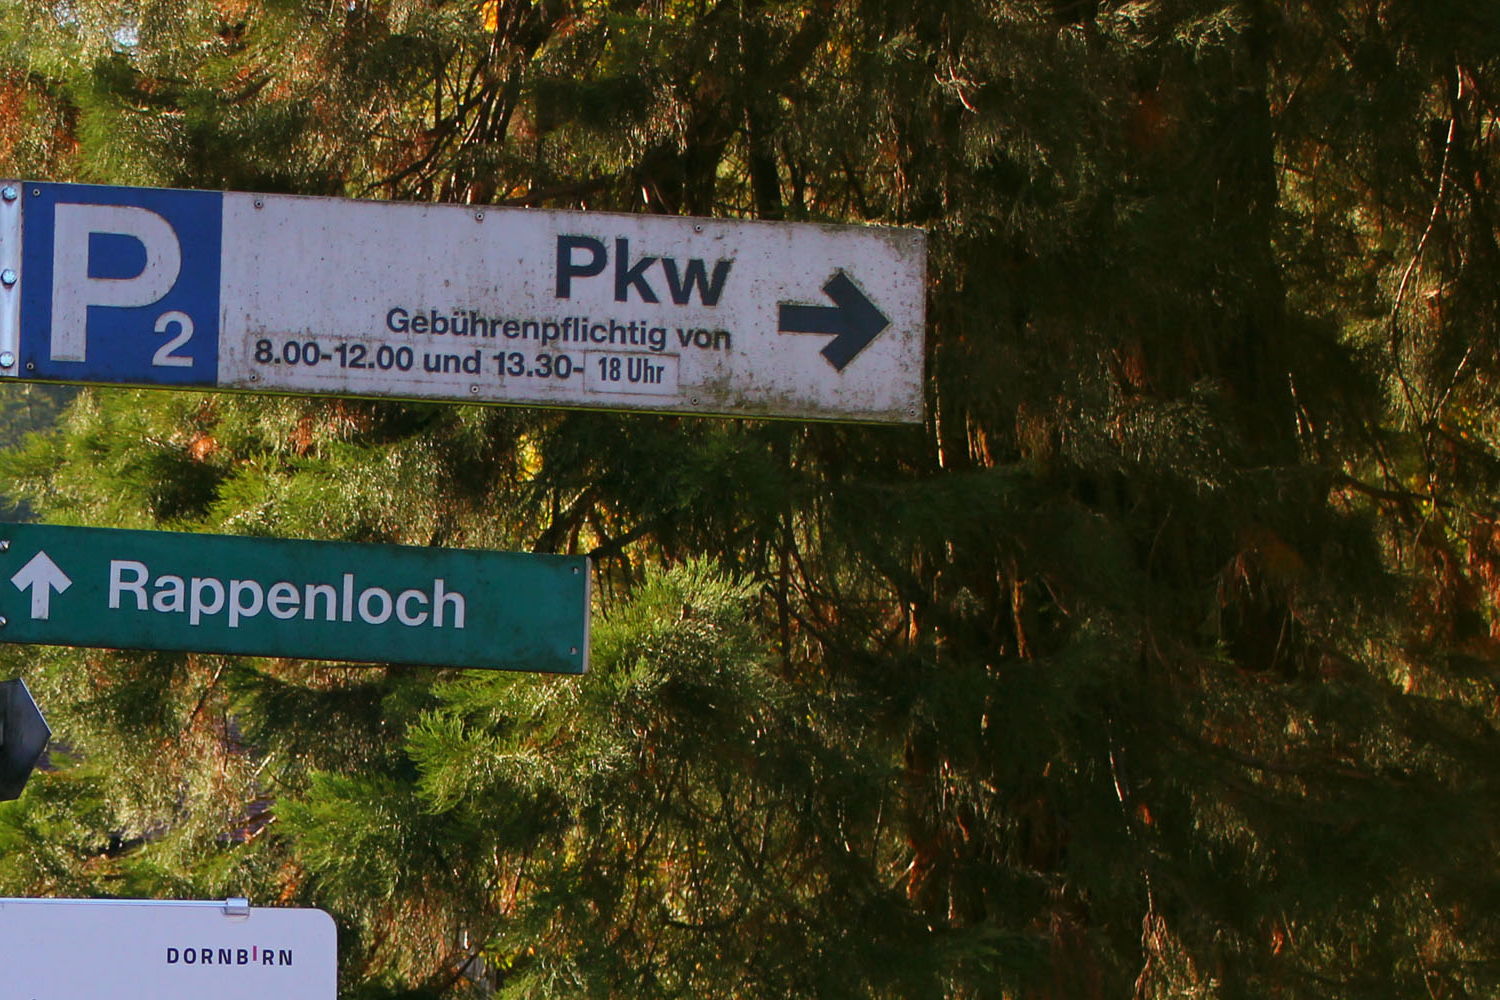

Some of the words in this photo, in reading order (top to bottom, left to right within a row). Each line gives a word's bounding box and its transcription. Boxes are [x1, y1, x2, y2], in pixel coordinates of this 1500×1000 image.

[50, 203, 182, 362] P
[152, 311, 194, 367] 2
[556, 234, 734, 306] Pkw
[386, 307, 667, 351] Gebührenpflichtig
[677, 328, 731, 350] von
[254, 340, 414, 370] 8.00-12.00
[424, 350, 481, 375] und
[492, 351, 584, 379] 13.30-
[598, 357, 621, 381] 18
[628, 357, 665, 384] Uhr
[109, 559, 465, 629] Rappenloch
[167, 945, 294, 966] DORNBIRN
